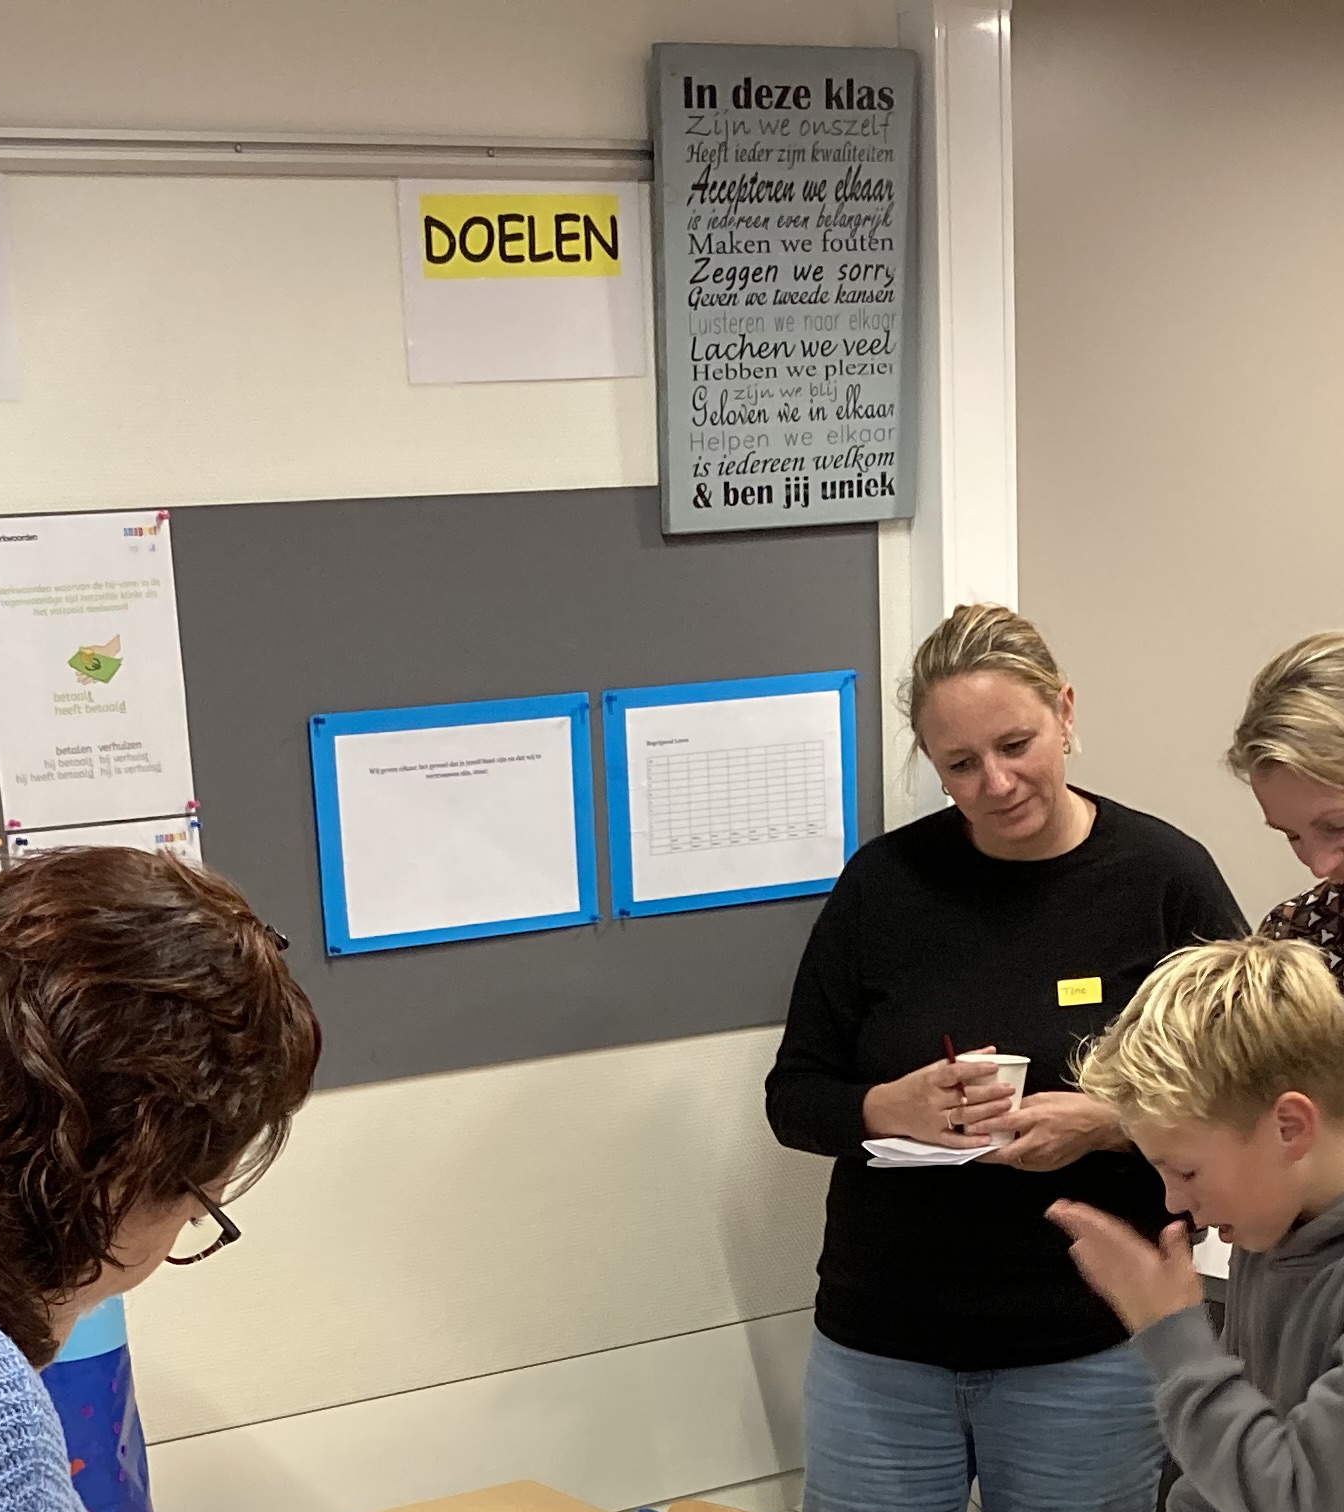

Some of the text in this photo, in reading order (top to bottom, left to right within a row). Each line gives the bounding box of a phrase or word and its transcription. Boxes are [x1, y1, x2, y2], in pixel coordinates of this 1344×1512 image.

[684, 76, 895, 110] In deze klas
[686, 109, 895, 144] Zijn we onszelf
[686, 141, 895, 170] Heeft ieder zijn kwaliteiten
[687, 164, 895, 214] Accepteren we elkaar
[687, 202, 895, 238] is iedereen even belangrijk
[424, 213, 618, 264] DOELEN
[688, 229, 894, 255] Maken we fouten
[689, 257, 895, 290] Zeggen we sorry
[688, 284, 895, 310] Geven we tweede kansen
[689, 308, 897, 337] Luisteren we naar elkaar
[691, 330, 896, 362] Lachen we veel
[692, 358, 894, 381] Hebben we plezier
[692, 384, 895, 426] Geloven we in elkaar
[733, 380, 838, 406] zijn we blij
[690, 424, 895, 454] Helpen we elkaar
[693, 445, 895, 478] is iedereen welkom
[693, 472, 895, 508] & ben jij uniek
[54, 690, 94, 702] betaalt
[55, 701, 127, 717] heeft betaald
[56, 745, 93, 756] betalen
[97, 741, 142, 753] verhuizen
[99, 755, 110, 765] hij
[15, 774, 27, 785] hij
[44, 759, 56, 771] hij
[101, 767, 111, 778] hij
